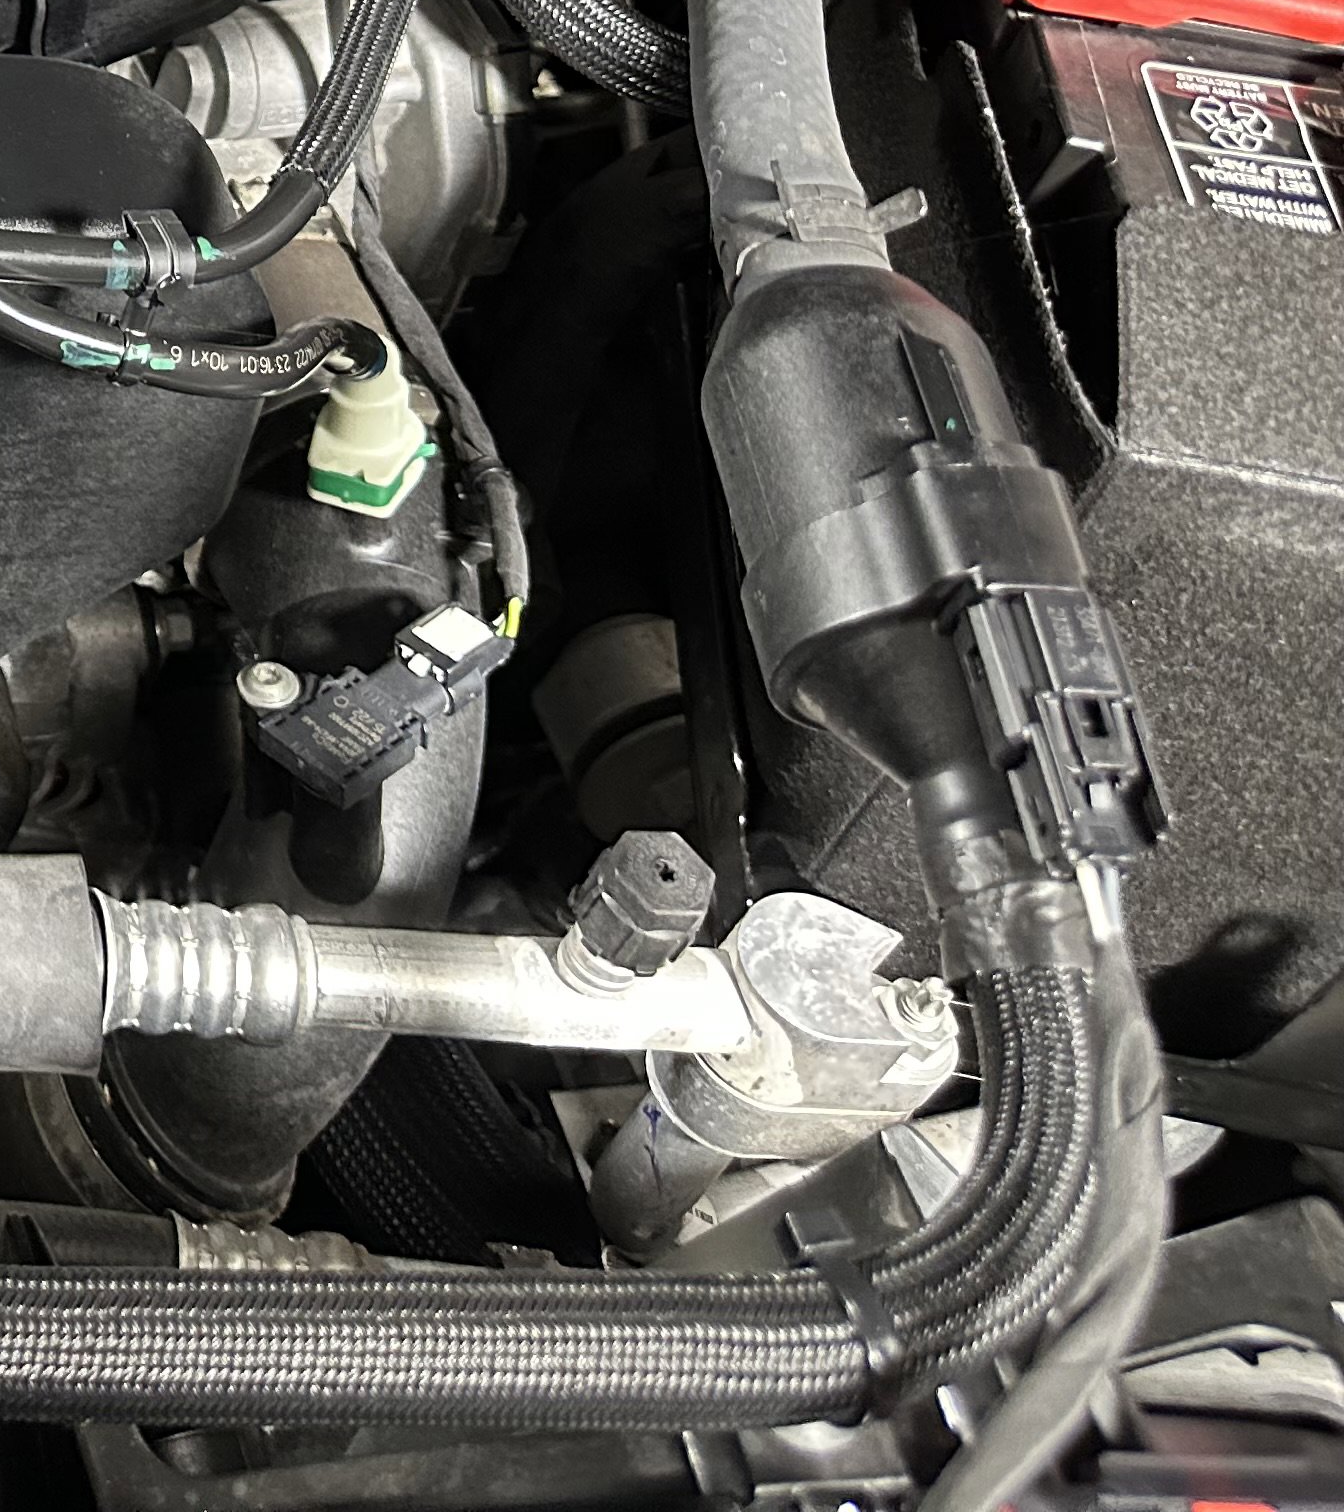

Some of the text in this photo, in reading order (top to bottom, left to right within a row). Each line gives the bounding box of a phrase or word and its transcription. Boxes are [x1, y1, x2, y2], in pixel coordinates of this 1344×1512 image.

[1188, 163, 1276, 192] MEDICAL
[1260, 164, 1312, 180] HELP
[1277, 199, 1328, 219] WITH
